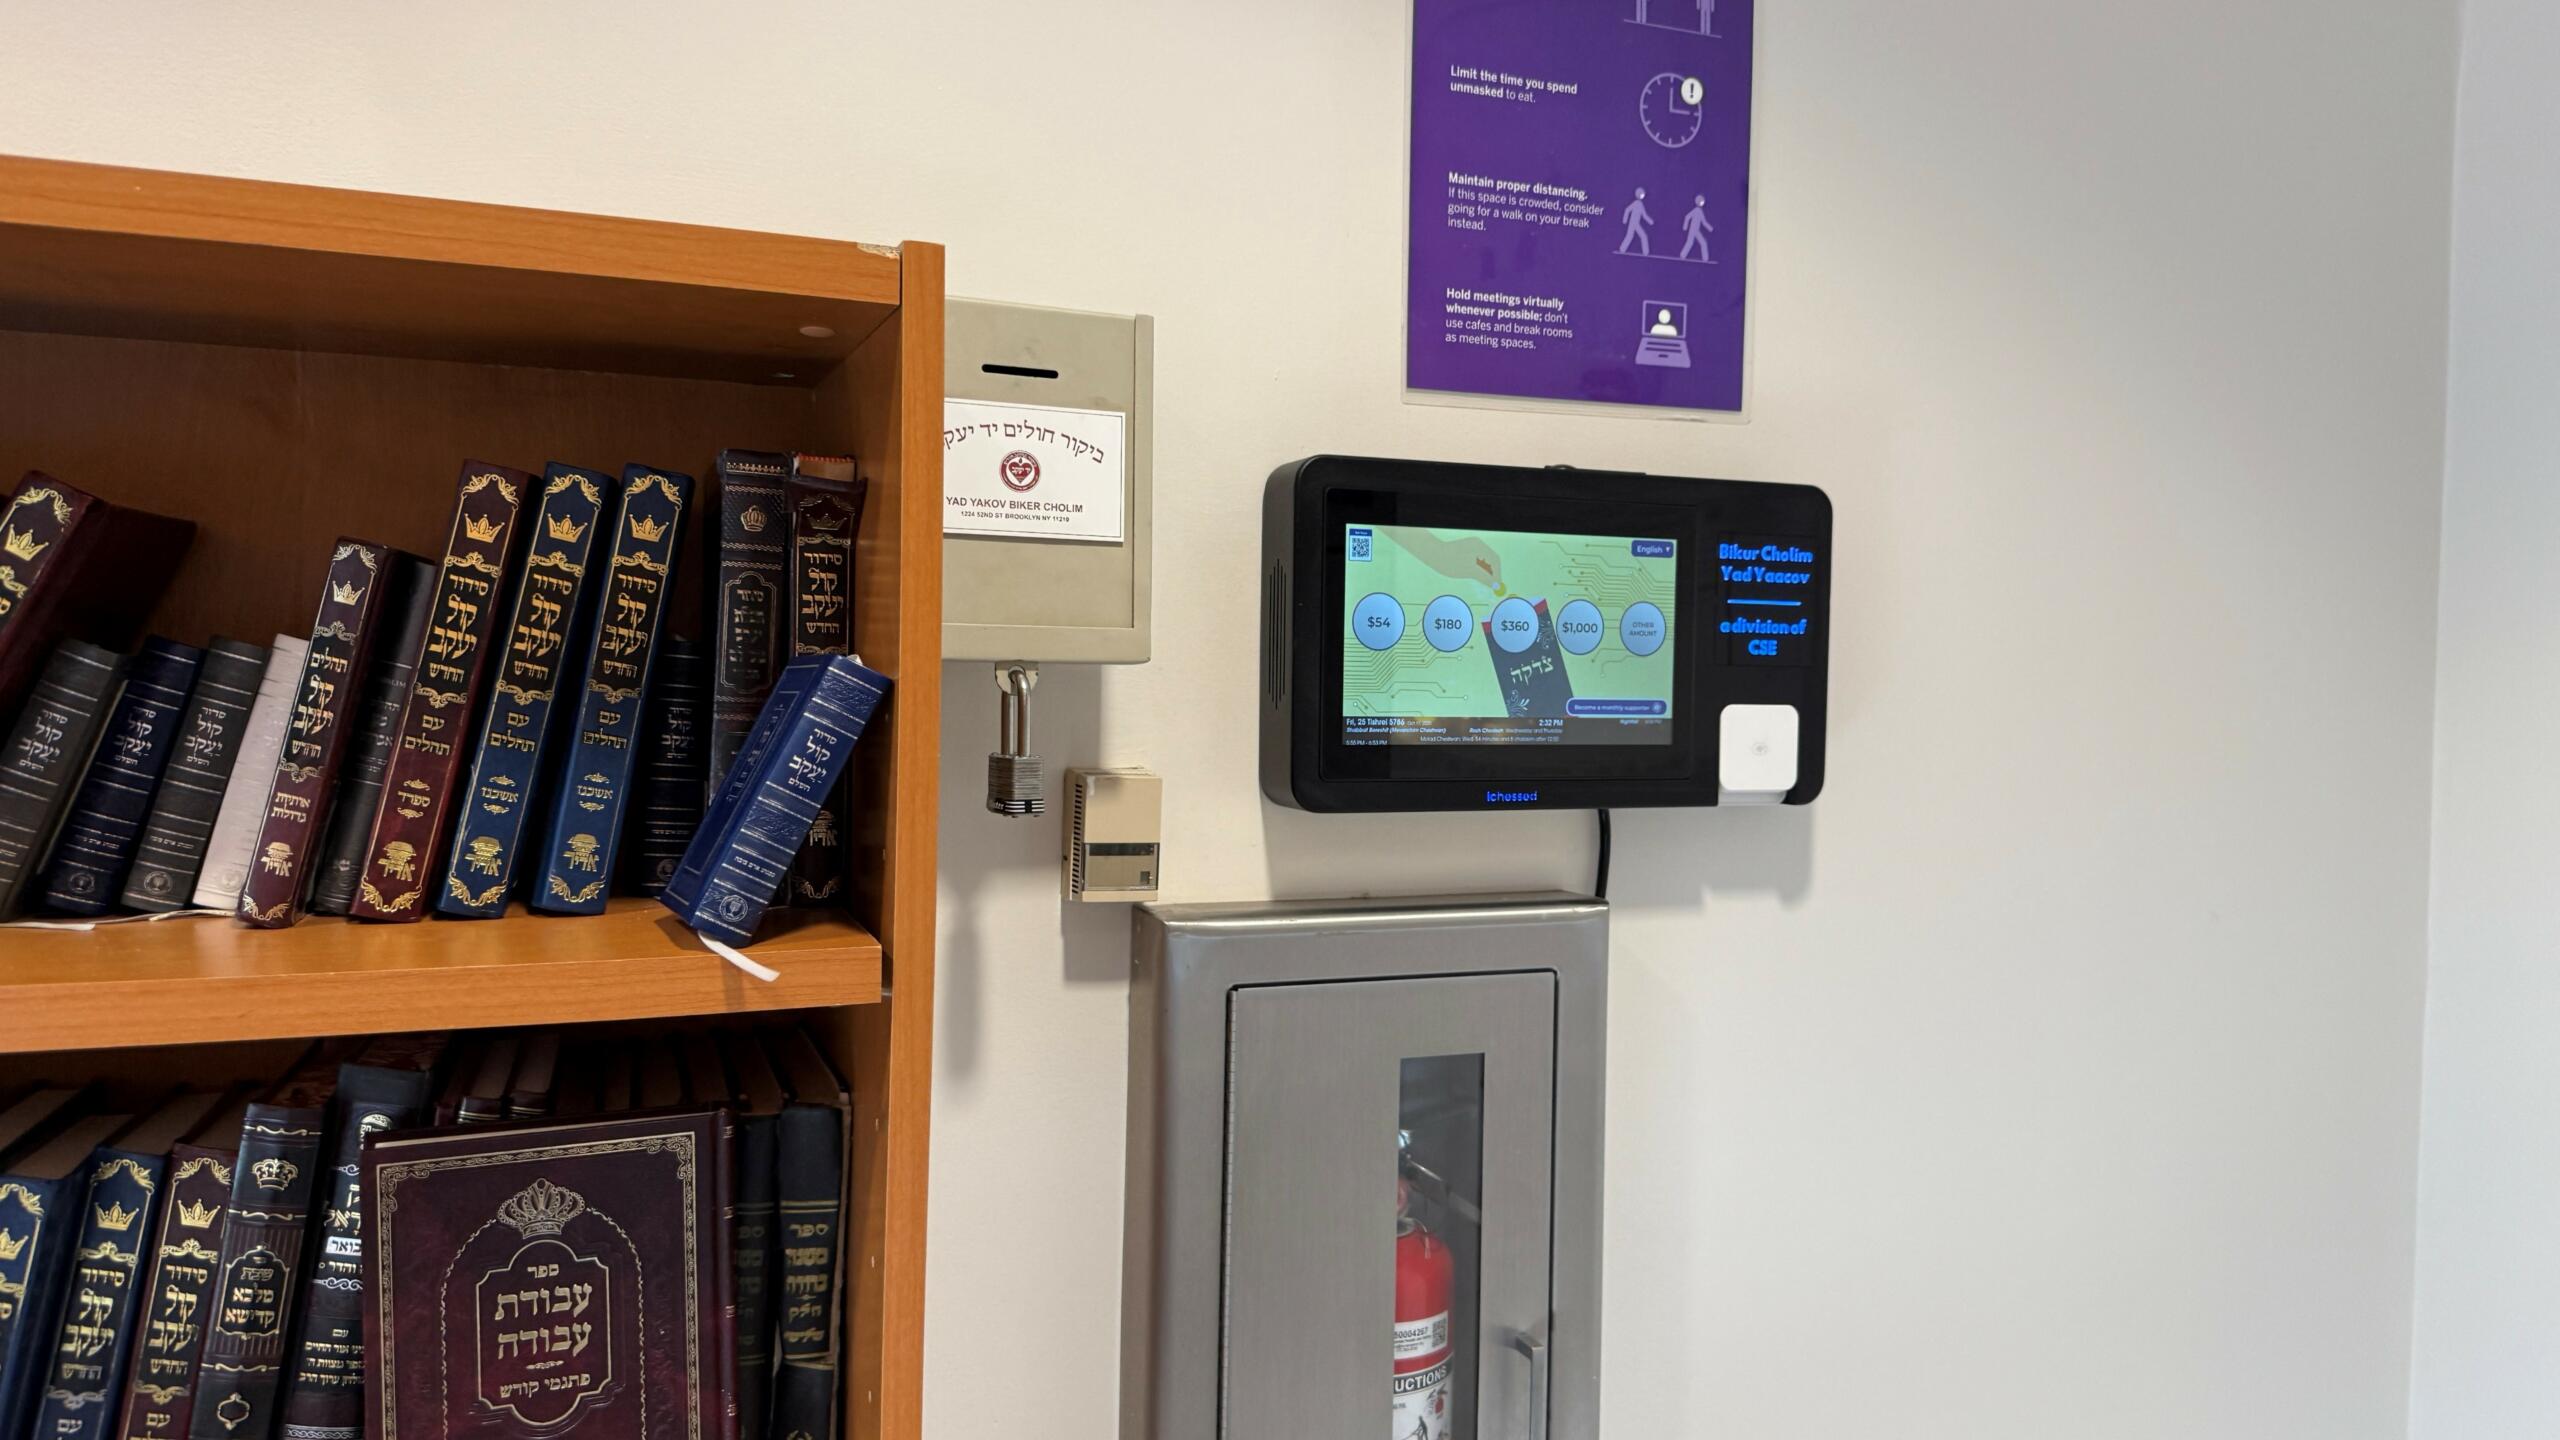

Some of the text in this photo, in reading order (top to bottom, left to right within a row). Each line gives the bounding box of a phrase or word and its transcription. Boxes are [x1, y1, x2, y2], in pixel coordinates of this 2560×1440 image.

[1450, 64, 1578, 95] Limit the time you spend
[1450, 82, 1536, 103] unmasked to eat.
[1449, 171, 1588, 201] Maintain proper distancing.
[1449, 186, 1604, 216] If this space is crowded, consider
[1448, 203, 1590, 229] going for a walk on your break
[1448, 217, 1487, 231] instead.
[1446, 288, 1564, 311] Hold meetings virtually
[1446, 303, 1568, 324] whenever possible; don't
[1446, 318, 1573, 338] use cafes and break rooms
[1445, 333, 1537, 350] as meeting spaces.
[943, 419, 1104, 463] ביקור חולים יד יעק
[945, 496, 1083, 513] YAD YAKOV BIKER CHOLIM
[1005, 513, 1041, 521] BROOKLYN
[804, 552, 842, 565] סידור
[1637, 545, 1663, 554] English
[1720, 543, 1813, 563] Bikur Cholim
[449, 574, 489, 596] סידור
[533, 573, 573, 595] סידור
[618, 573, 657, 594] סידור
[808, 567, 838, 598] קול
[1721, 565, 1810, 584] Yad Yaacov
[446, 594, 478, 633] קול
[529, 592, 562, 630] קול
[617, 592, 647, 630] קול
[801, 593, 844, 619] יעקב
[806, 622, 840, 634] החדש
[1367, 616, 1391, 628] $54
[1434, 618, 1462, 631] $180
[1500, 620, 1530, 632] $360
[1562, 622, 1598, 635] $1,000
[1720, 617, 1807, 634] a division of
[428, 625, 478, 660] יעקב
[513, 624, 562, 658] יעקב
[602, 625, 649, 657] יעקב
[1629, 629, 1657, 637] AMOUNT
[1748, 639, 1778, 656] CSE
[310, 647, 348, 673] תהלים
[513, 660, 549, 681] החדש
[603, 659, 638, 680] החדש
[428, 662, 465, 684] החדש
[308, 674, 335, 707] קול
[202, 706, 226, 719] סדור
[292, 704, 334, 736] יעקב
[422, 714, 445, 731] עם
[507, 711, 530, 728] עם
[599, 710, 621, 726] עם
[35, 716, 63, 743] קול
[197, 714, 223, 736] קול
[184, 734, 223, 756] יעקב
[404, 732, 451, 756] תהלים
[490, 729, 535, 752] תהלים
[583, 727, 627, 749] תהלים
[814, 728, 837, 745] סדור
[18, 737, 61, 761] יעקב
[292, 738, 322, 759] החדש
[806, 735, 830, 763] קול
[788, 754, 827, 783] יעקב
[788, 775, 811, 792] השלם
[397, 790, 431, 807] ספרד
[788, 1223, 829, 1239] ספר
[332, 1239, 362, 1253] בואר
[80, 1268, 125, 1287] סידור
[165, 1264, 208, 1284] סידור
[527, 1263, 559, 1279] ספר
[79, 1288, 114, 1325] קול
[165, 1284, 198, 1323] קול
[495, 1282, 592, 1320] עבודת
[61, 1323, 115, 1359] יעקב
[148, 1320, 199, 1354] יעקב
[498, 1322, 592, 1360] עבודה
[150, 1358, 188, 1375] החדש
[500, 1373, 591, 1399] פתגמי קודש
[1394, 1365, 1447, 1393] UCTIONS
[57, 1418, 83, 1433] עם
[145, 1412, 171, 1428] עם
